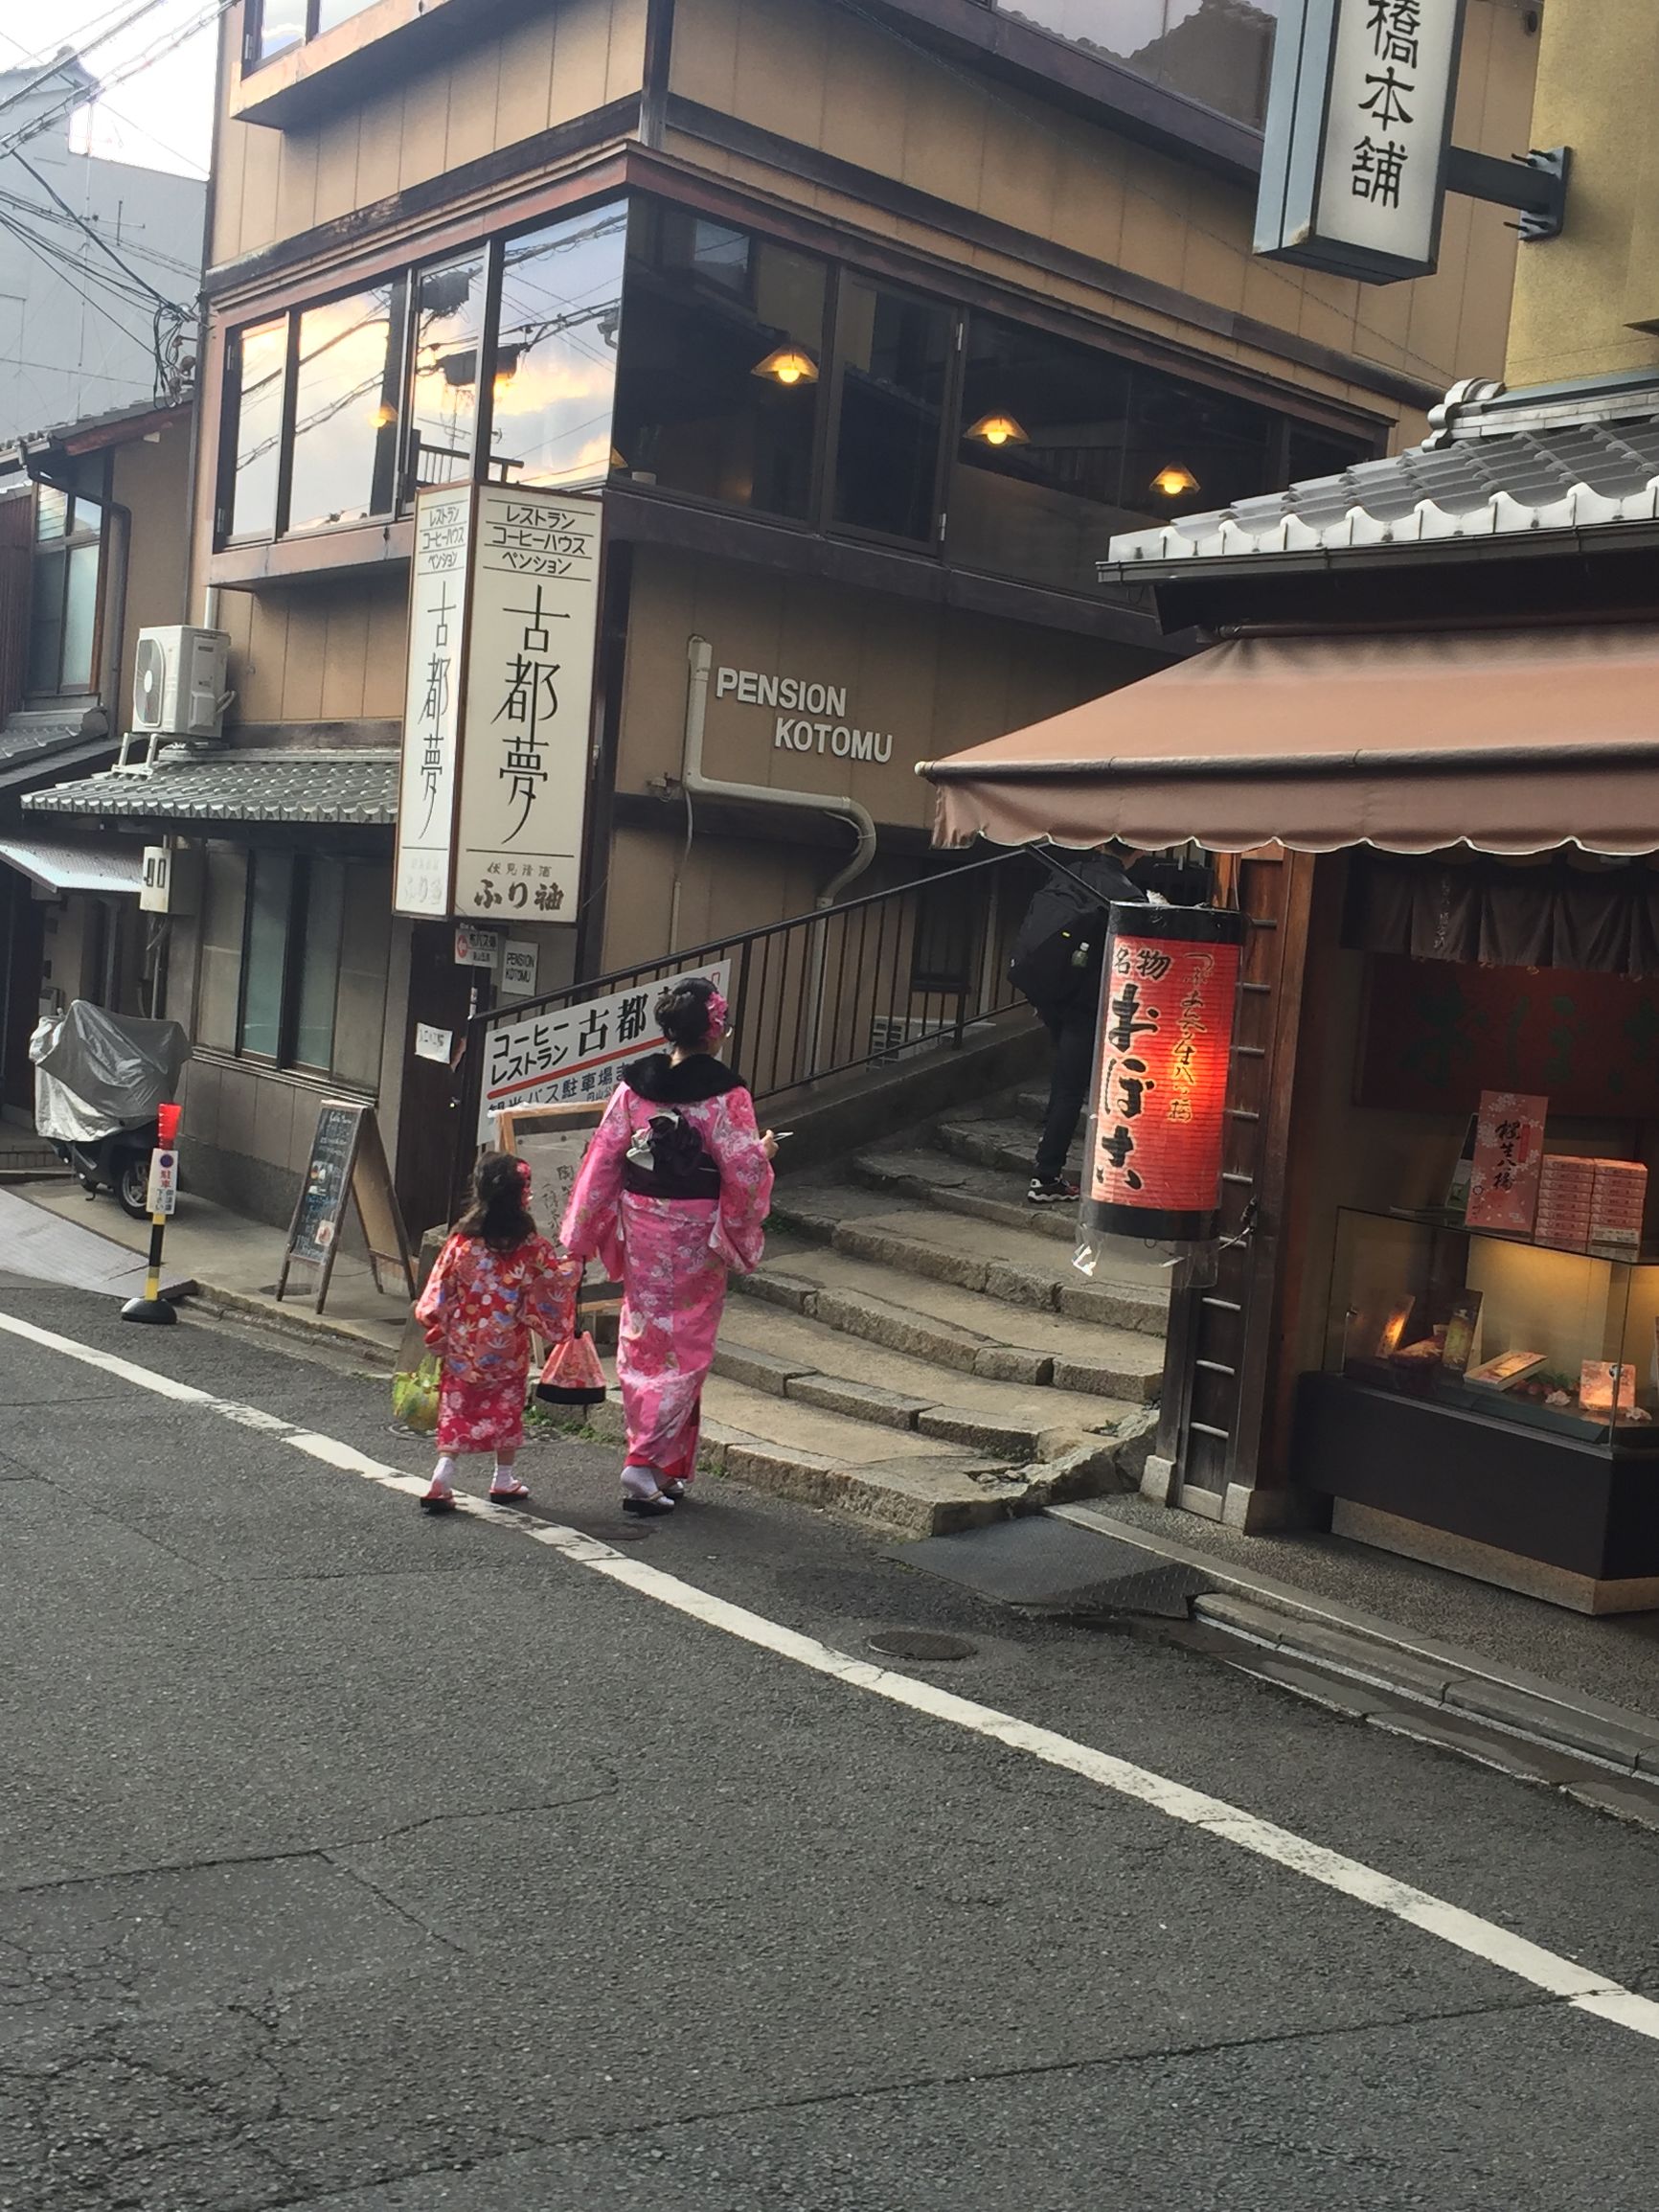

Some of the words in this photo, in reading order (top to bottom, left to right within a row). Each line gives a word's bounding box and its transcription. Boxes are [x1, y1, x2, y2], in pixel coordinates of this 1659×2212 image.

[429, 507, 459, 527] レストラン
[507, 505, 576, 530] レストラン
[422, 527, 465, 550] コーヒーハウス
[492, 526, 586, 555] コーヒーハウス
[427, 551, 458, 570] ペンション
[502, 551, 573, 575] ペンション
[716, 667, 847, 717] PENSION
[418, 581, 457, 840] 古都夢
[490, 584, 571, 845] 古都夢
[775, 718, 893, 764] KOTOMU
[474, 878, 564, 911] ふり袖
[506, 968, 531, 983] KOTOMU
[507, 952, 534, 968] PENSION
[1115, 946, 1170, 982] 名物
[578, 987, 670, 1058] 古都
[493, 1022, 570, 1059] コーヒー
[490, 1044, 569, 1085] レストラン
